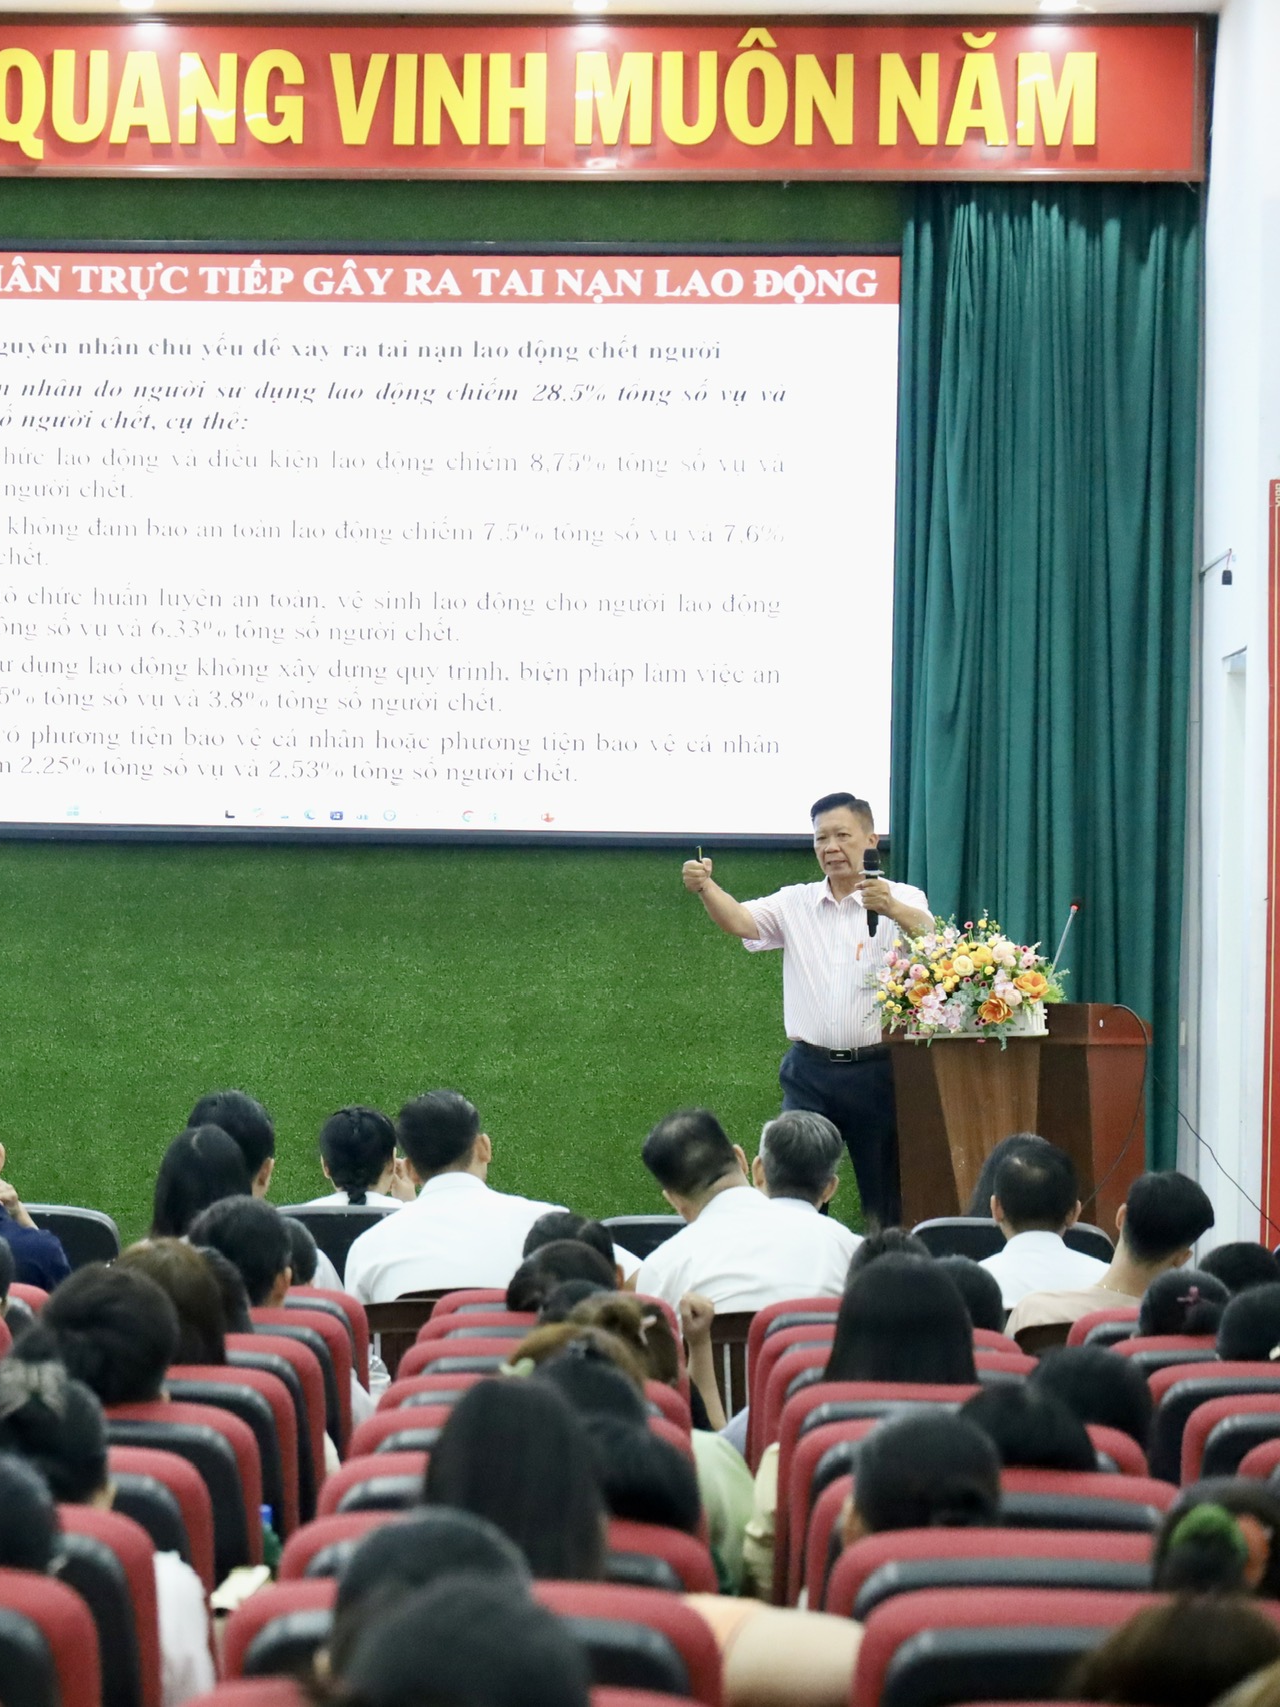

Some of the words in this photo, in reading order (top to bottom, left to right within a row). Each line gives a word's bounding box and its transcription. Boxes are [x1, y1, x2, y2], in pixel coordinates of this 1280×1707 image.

[330, 52, 547, 147] VINH
[574, 28, 854, 147] MUÔN
[879, 32, 1097, 147] NĂM
[72, 262, 189, 300] TRỰC
[199, 259, 294, 294] TIẾP
[303, 259, 393, 295] GÂY
[404, 268, 462, 296] RA
[473, 269, 544, 296] TAI
[555, 269, 643, 303] NẠN
[655, 269, 743, 297] LAO
[753, 265, 878, 303] ĐỘNG
[78, 335, 139, 356] nhân
[201, 331, 243, 361] yếu
[343, 344, 368, 358] ra
[377, 339, 408, 359] tai
[417, 345, 463, 364] nạn
[472, 339, 510, 359] lao
[588, 334, 638, 360] chết
[649, 340, 721, 363] người
[20, 378, 83, 398] nhân
[93, 379, 123, 398] do
[132, 379, 207, 403] người
[254, 380, 317, 405] dụng
[327, 381, 364, 400] lao
[446, 376, 519, 402] chiếm
[681, 378, 709, 402] số
[721, 389, 748, 407] vụ
[761, 383, 787, 403] và
[20, 409, 94, 433] người
[165, 416, 194, 435] cụ
[4, 478, 70, 503] người
[79, 473, 133, 499] chết.
[27, 585, 83, 606] chức
[93, 581, 148, 607] huấn
[159, 587, 222, 612] luyện
[232, 594, 259, 608] an
[337, 590, 364, 613] vệ
[374, 590, 421, 610] sinh
[433, 590, 467, 611] lao
[545, 592, 588, 612] cho
[598, 592, 665, 618] người
[678, 593, 712, 613] lao
[47, 611, 71, 637] số
[79, 623, 107, 641] vụ
[116, 617, 142, 638] và
[294, 615, 320, 640] số
[329, 621, 395, 646] người
[405, 616, 460, 642] chết.
[20, 654, 79, 681] dụng
[89, 655, 123, 675] lao
[197, 656, 269, 683] không
[278, 658, 320, 684] xây
[328, 658, 388, 685] dựng
[396, 665, 439, 685] quy
[519, 660, 569, 686] biện
[578, 661, 635, 688] pháp
[644, 662, 686, 684] làm
[696, 663, 745, 687] việc
[753, 669, 780, 684] an
[102, 682, 128, 707] số
[137, 693, 164, 711] vụ
[173, 688, 199, 708] và
[337, 685, 363, 710] số
[371, 691, 438, 717] người
[447, 687, 502, 712] chết.
[31, 724, 121, 751] phương
[130, 725, 173, 750] tiện
[236, 727, 262, 751] vệ
[272, 728, 297, 748] cá
[309, 728, 364, 749] nhân
[375, 729, 430, 754] hoặc
[440, 730, 531, 757] phương
[542, 731, 585, 755] tiện
[650, 733, 676, 757] vệ
[686, 733, 712, 753] cá
[723, 733, 779, 754] nhân
[162, 752, 188, 777] số
[197, 763, 224, 781] vụ
[233, 758, 259, 778] và
[412, 755, 438, 780] số
[446, 761, 514, 787] người
[522, 756, 578, 782] chết.
